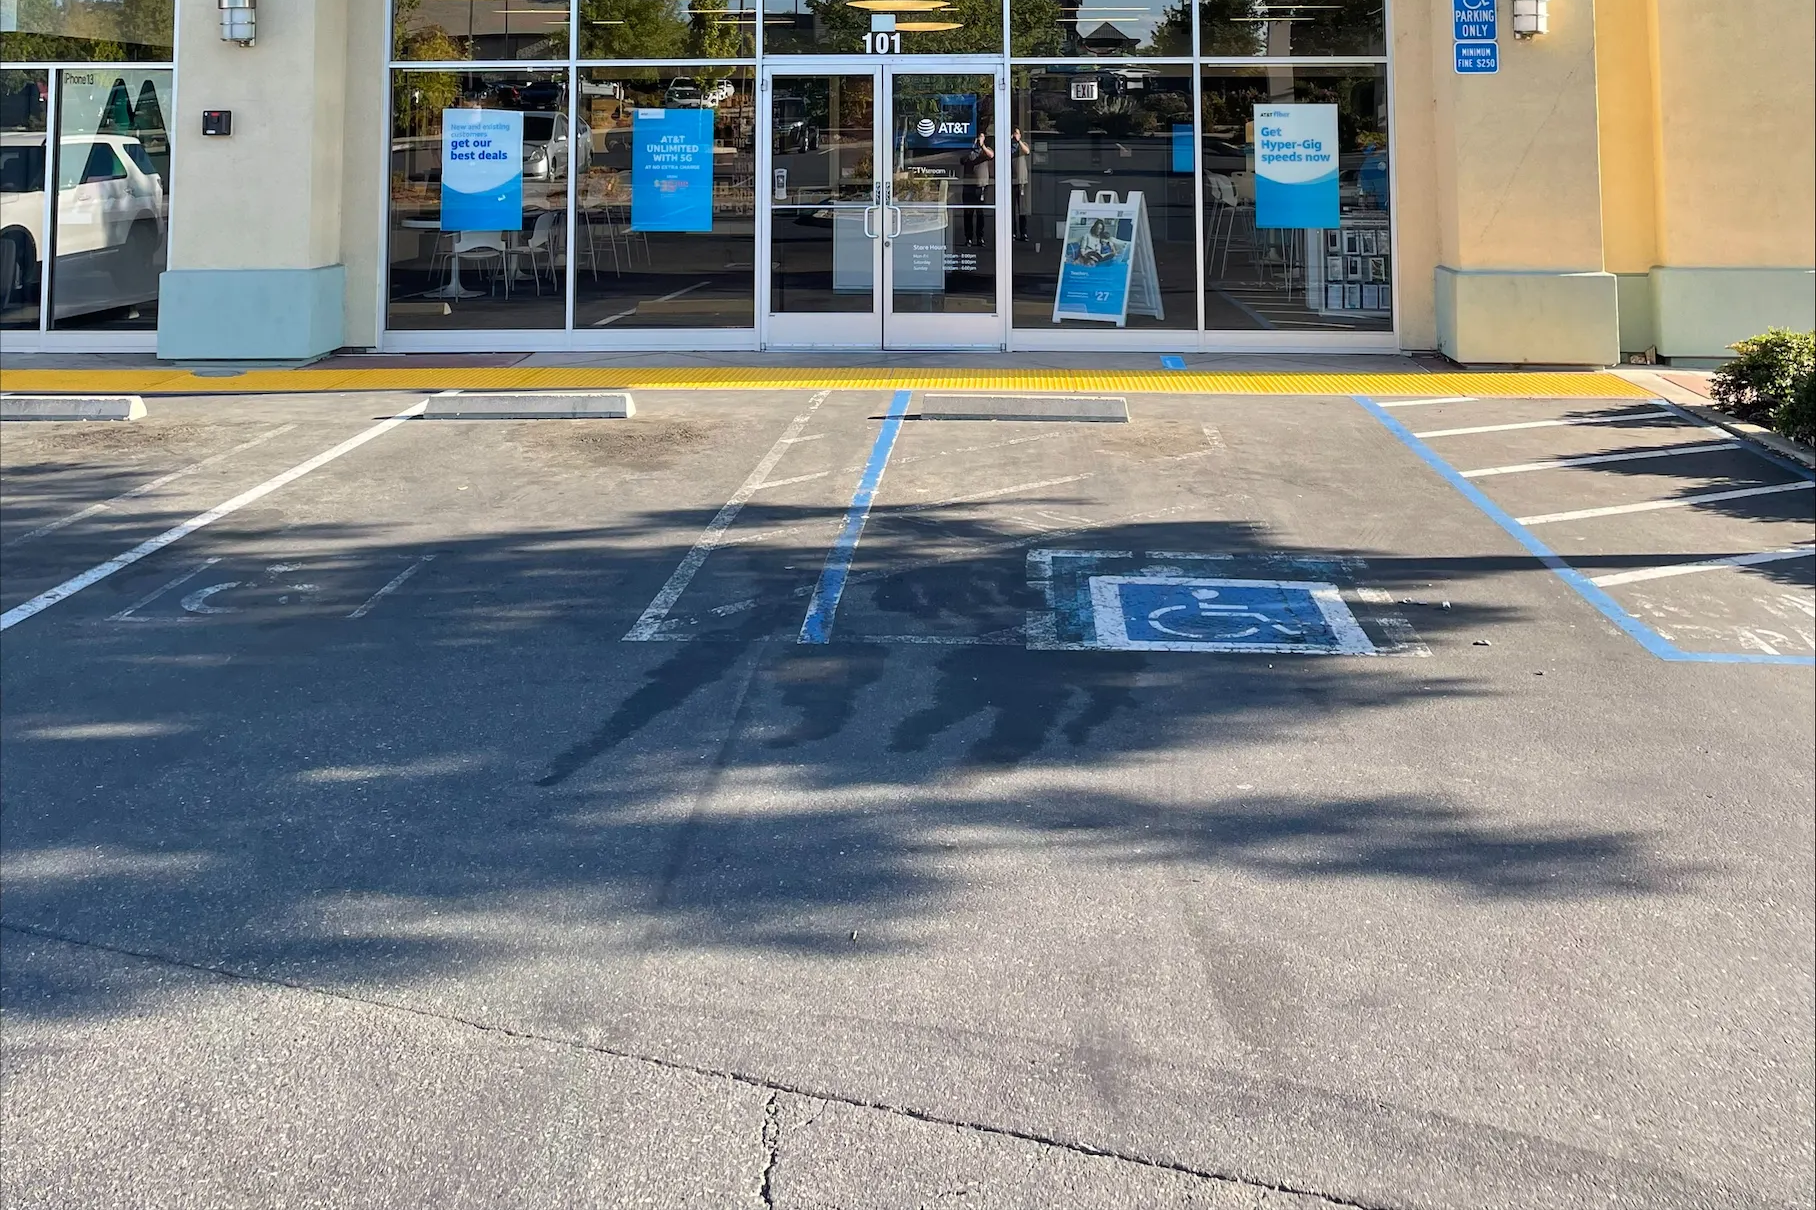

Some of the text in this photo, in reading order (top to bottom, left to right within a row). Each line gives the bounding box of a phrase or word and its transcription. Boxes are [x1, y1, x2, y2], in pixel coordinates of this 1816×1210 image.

[1455, 10, 1495, 23] PARKING
[1462, 24, 1488, 37] ONLY
[862, 32, 901, 54] 101
[1461, 48, 1491, 57] MINIMUM
[1457, 58, 1496, 68] FINE $250
[64, 73, 94, 85] iPhone 13
[1076, 84, 1095, 98] EXIT
[451, 123, 510, 132] New and existing
[938, 122, 970, 134] AT&T
[1260, 127, 1282, 137] Get
[451, 139, 492, 150] get our
[660, 135, 686, 143] AT&T
[646, 144, 699, 153] UNLIMITED
[1261, 139, 1322, 152] Hyper-Gig
[450, 150, 508, 160] best deals
[653, 154, 693, 162] WITH 5G
[1261, 152, 1331, 164] speeds now
